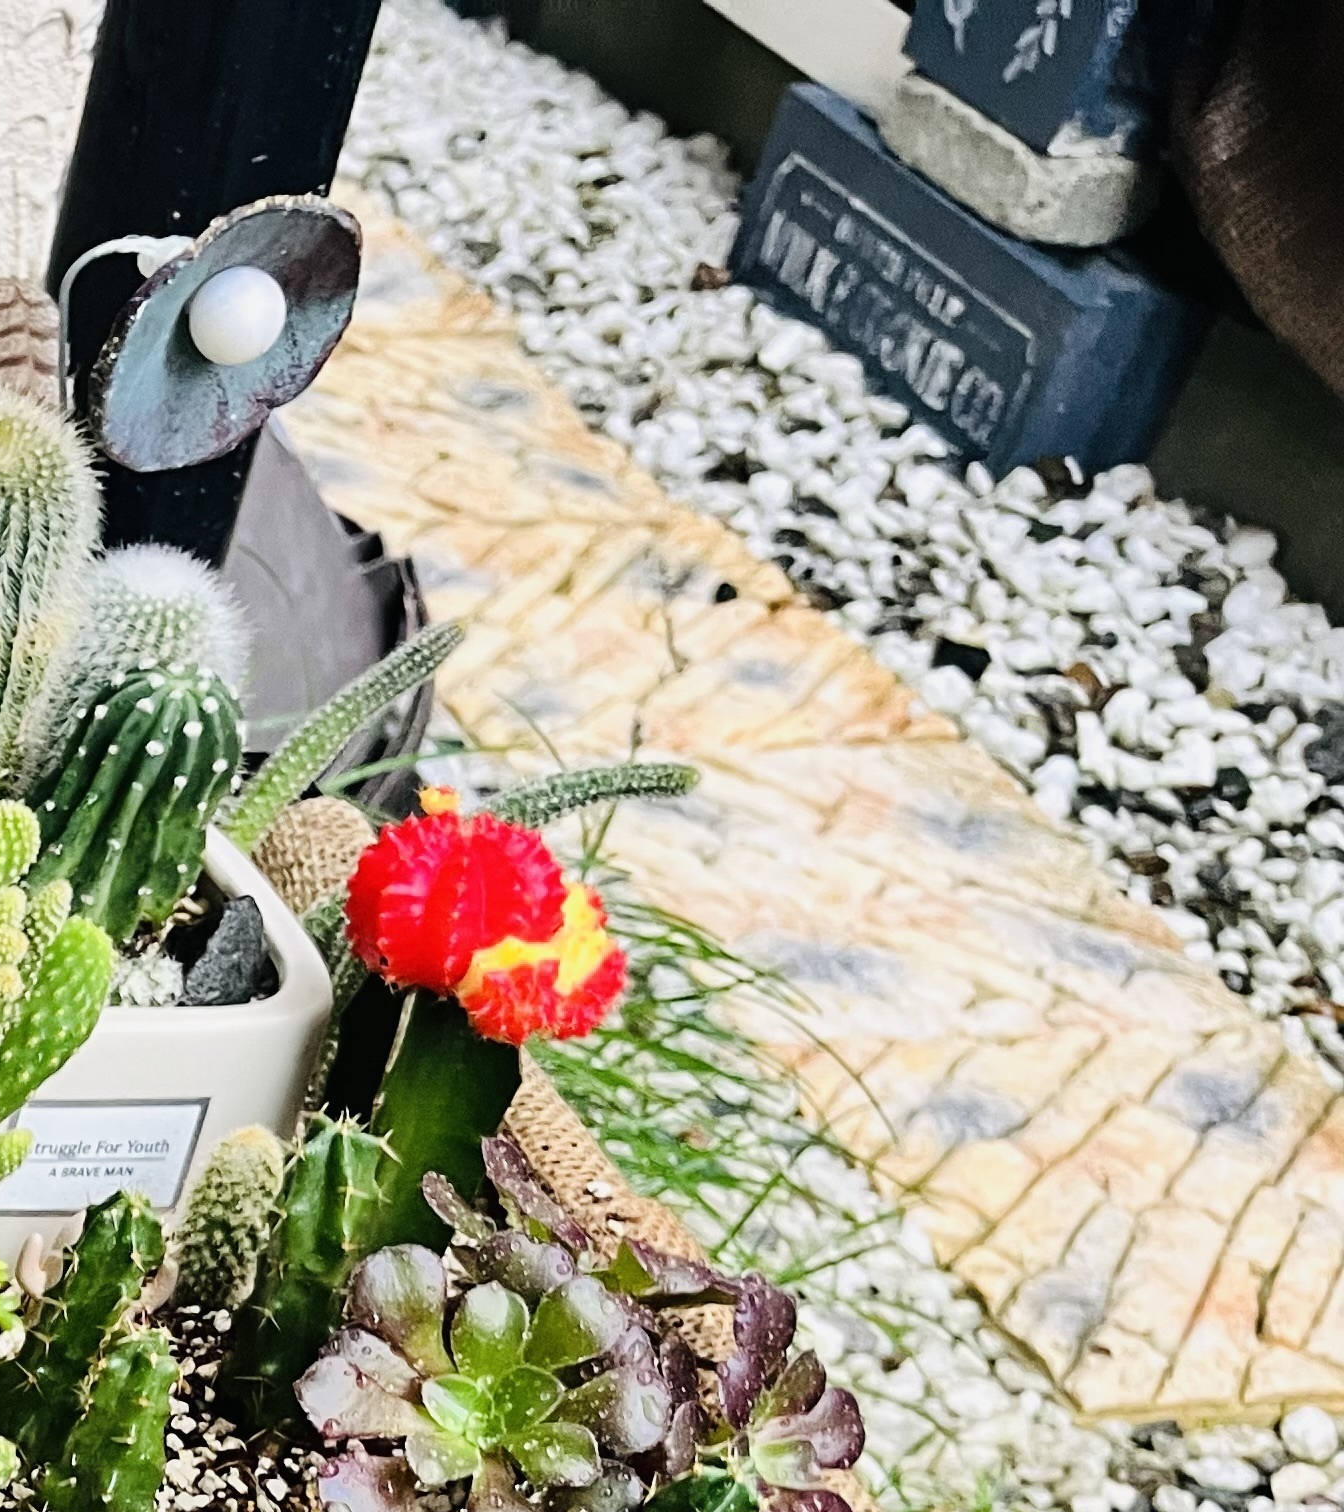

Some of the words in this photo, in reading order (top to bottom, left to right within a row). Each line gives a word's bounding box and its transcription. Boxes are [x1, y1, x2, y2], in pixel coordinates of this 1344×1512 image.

[33, 1139, 92, 1159] truggle
[95, 1140, 122, 1154] For
[127, 1138, 170, 1153] Youth
[48, 1168, 57, 1177] A
[61, 1166, 101, 1177] BRAVE
[103, 1166, 134, 1177] MAN
